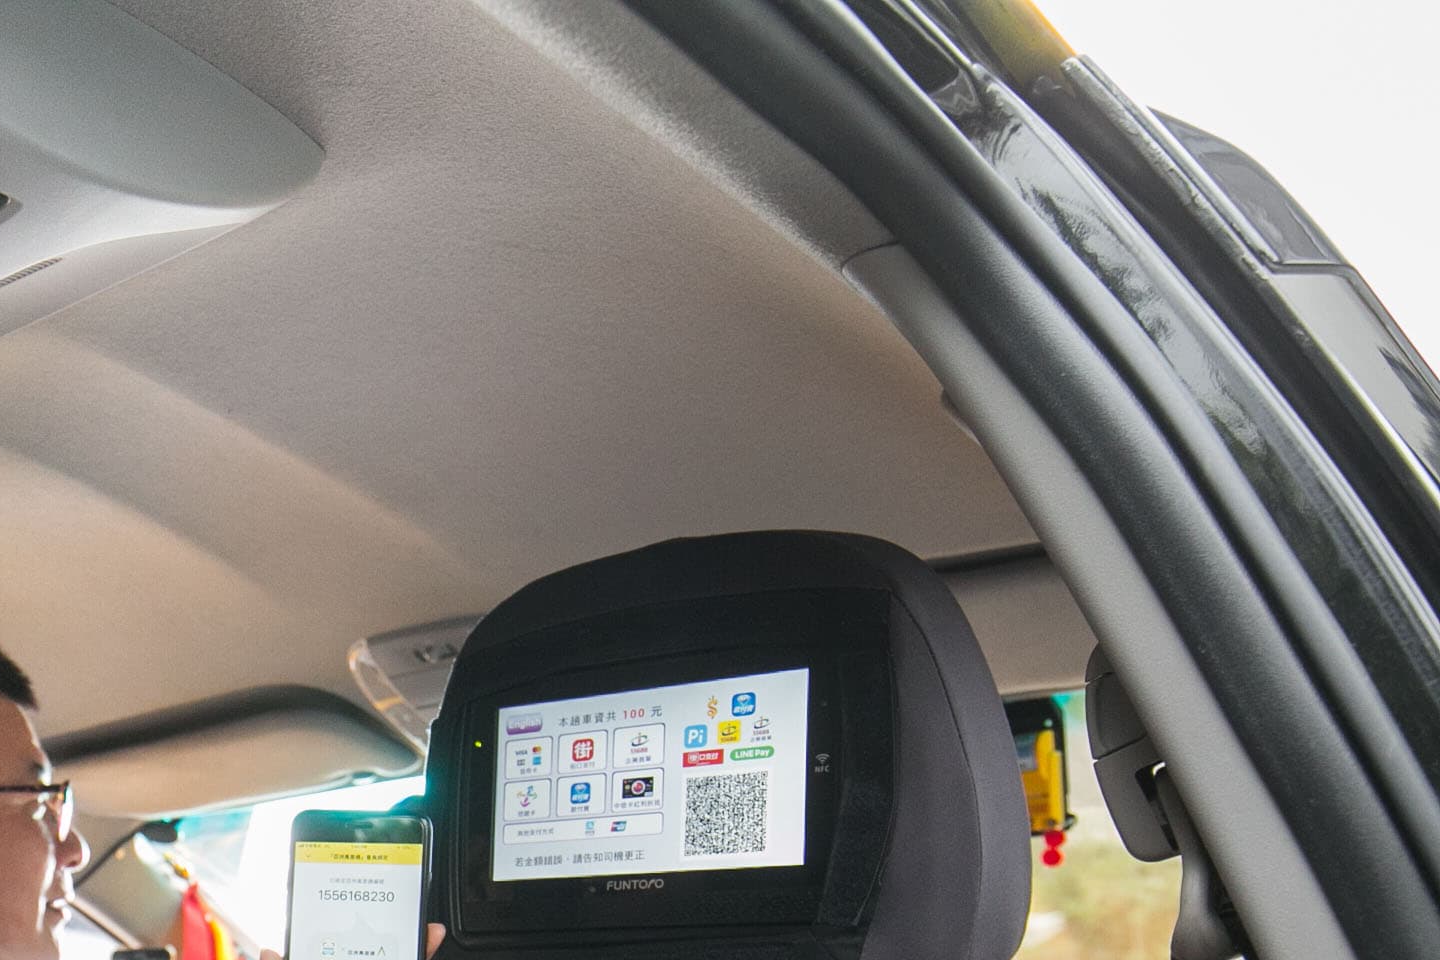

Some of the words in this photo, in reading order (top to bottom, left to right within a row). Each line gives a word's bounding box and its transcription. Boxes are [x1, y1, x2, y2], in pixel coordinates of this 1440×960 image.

[623, 708, 645, 719] 100
[650, 705, 663, 717] 元
[688, 729, 704, 744] Pi
[735, 750, 754, 760] LINE
[755, 748, 770, 758] Pay
[318, 889, 395, 903] 1556168230
